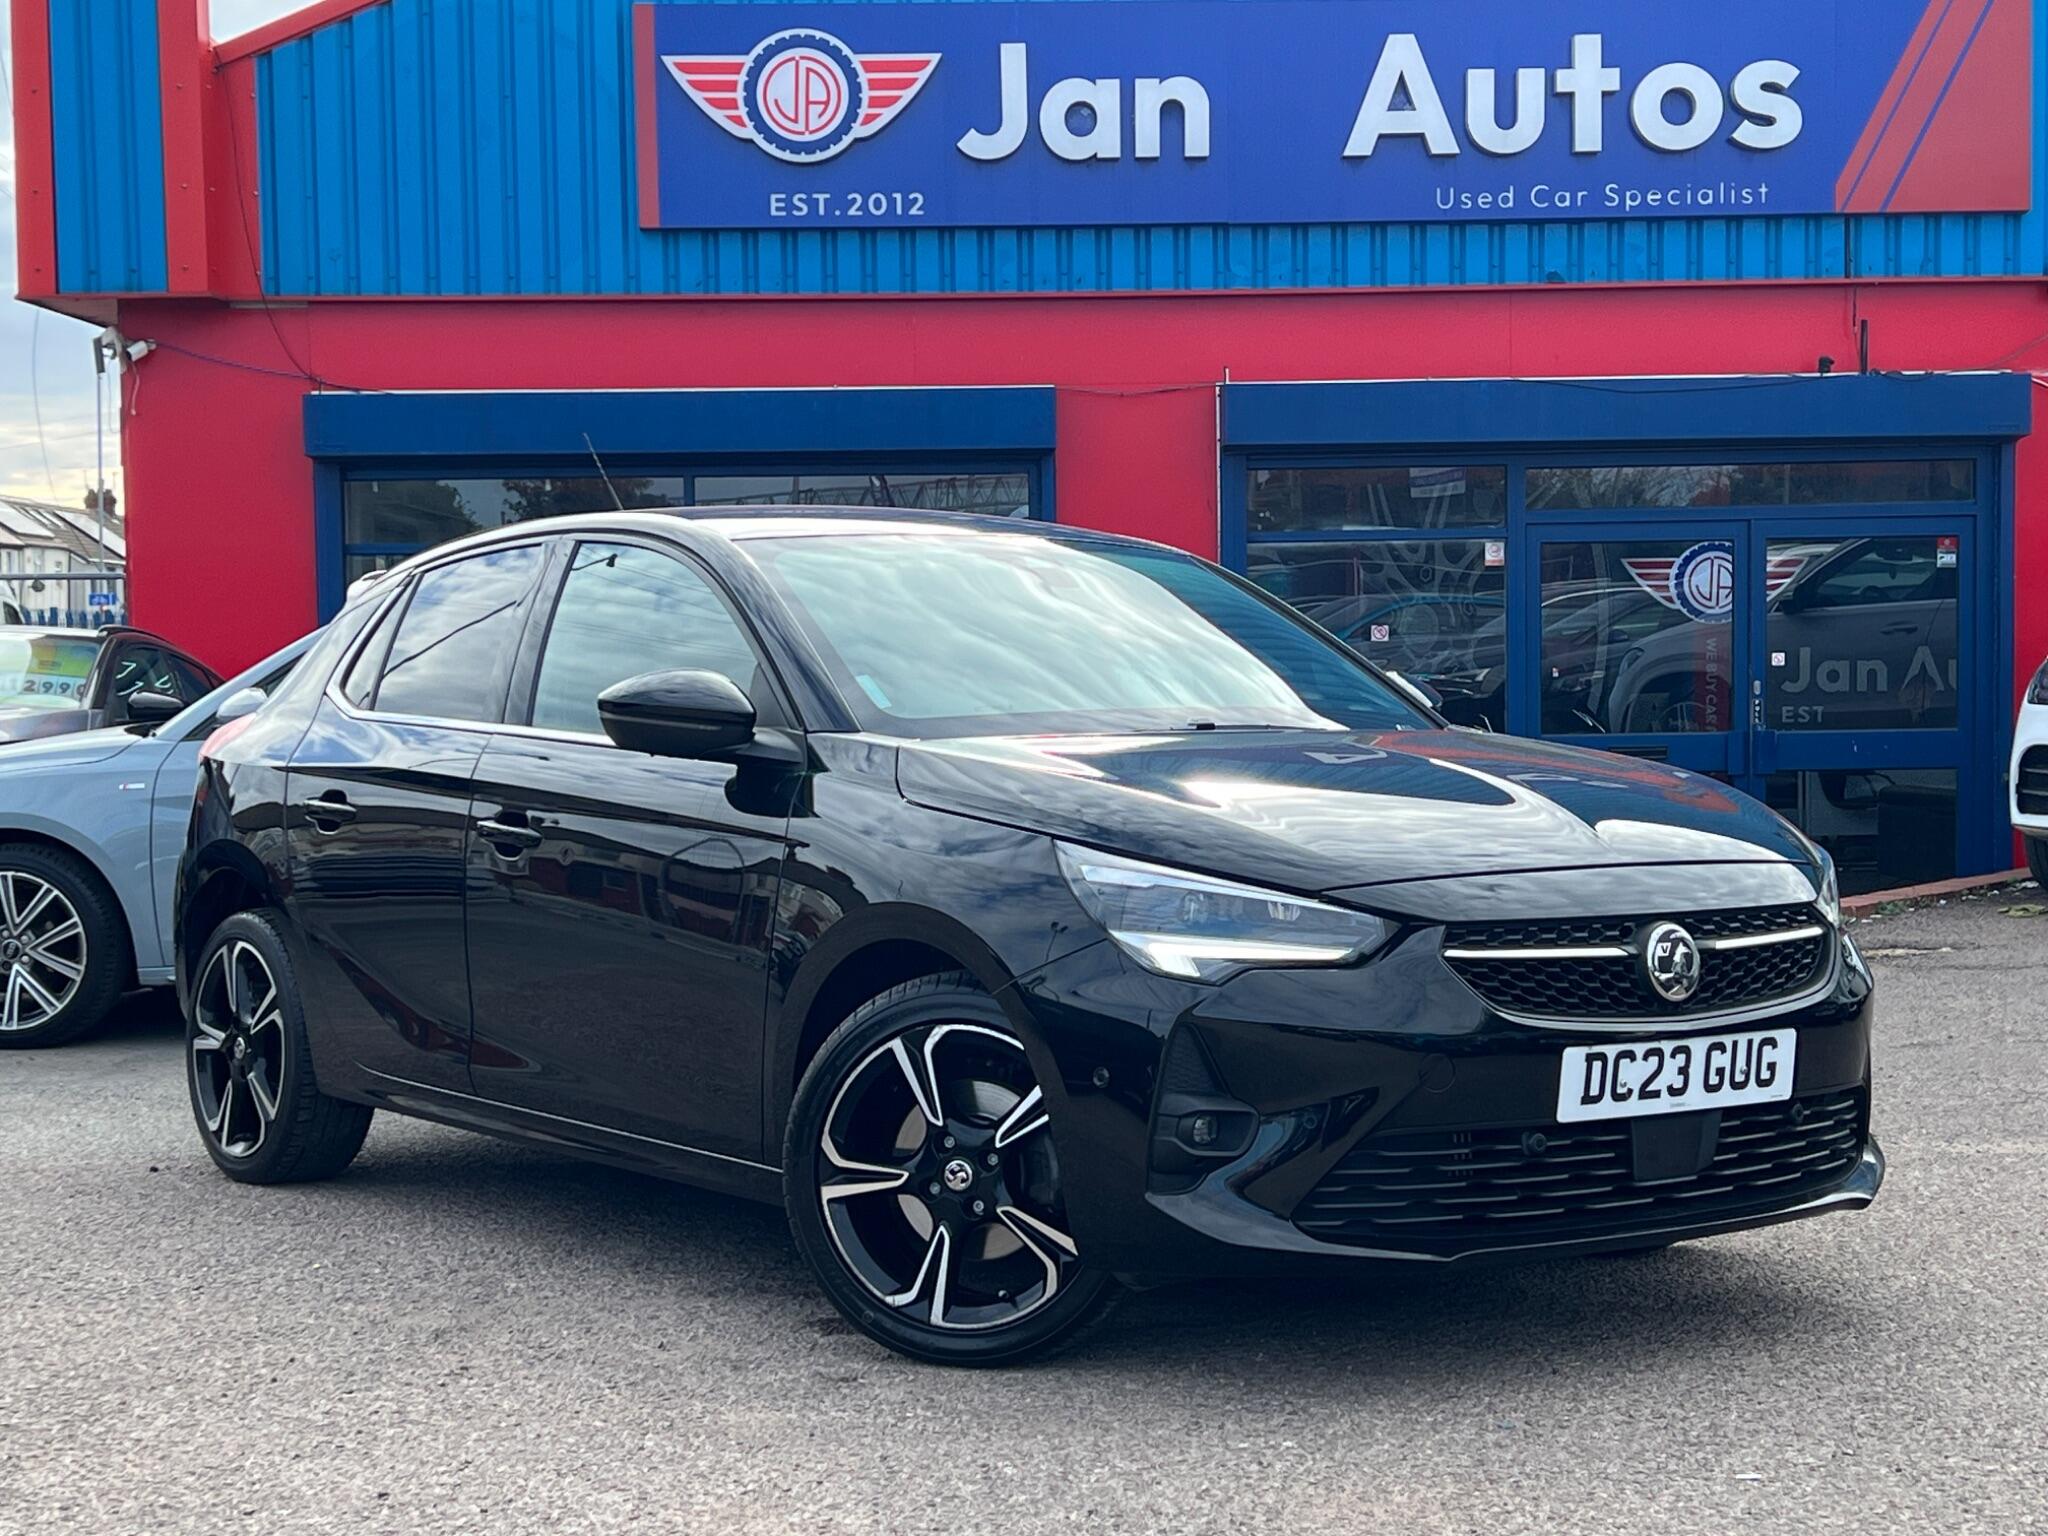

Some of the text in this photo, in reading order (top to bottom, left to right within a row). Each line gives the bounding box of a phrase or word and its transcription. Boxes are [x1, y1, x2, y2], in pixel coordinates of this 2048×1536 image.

[956, 32, 1804, 160] Jan Autos
[769, 191, 926, 217] EST.2012
[1436, 182, 1770, 212] Used Car Specialist
[1705, 638, 1718, 660] WE
[1705, 663, 1718, 693] BUY
[1781, 646, 1888, 693] Jan
[1781, 706, 1825, 723] EST
[1581, 1036, 1778, 1106] DC23 GUG
